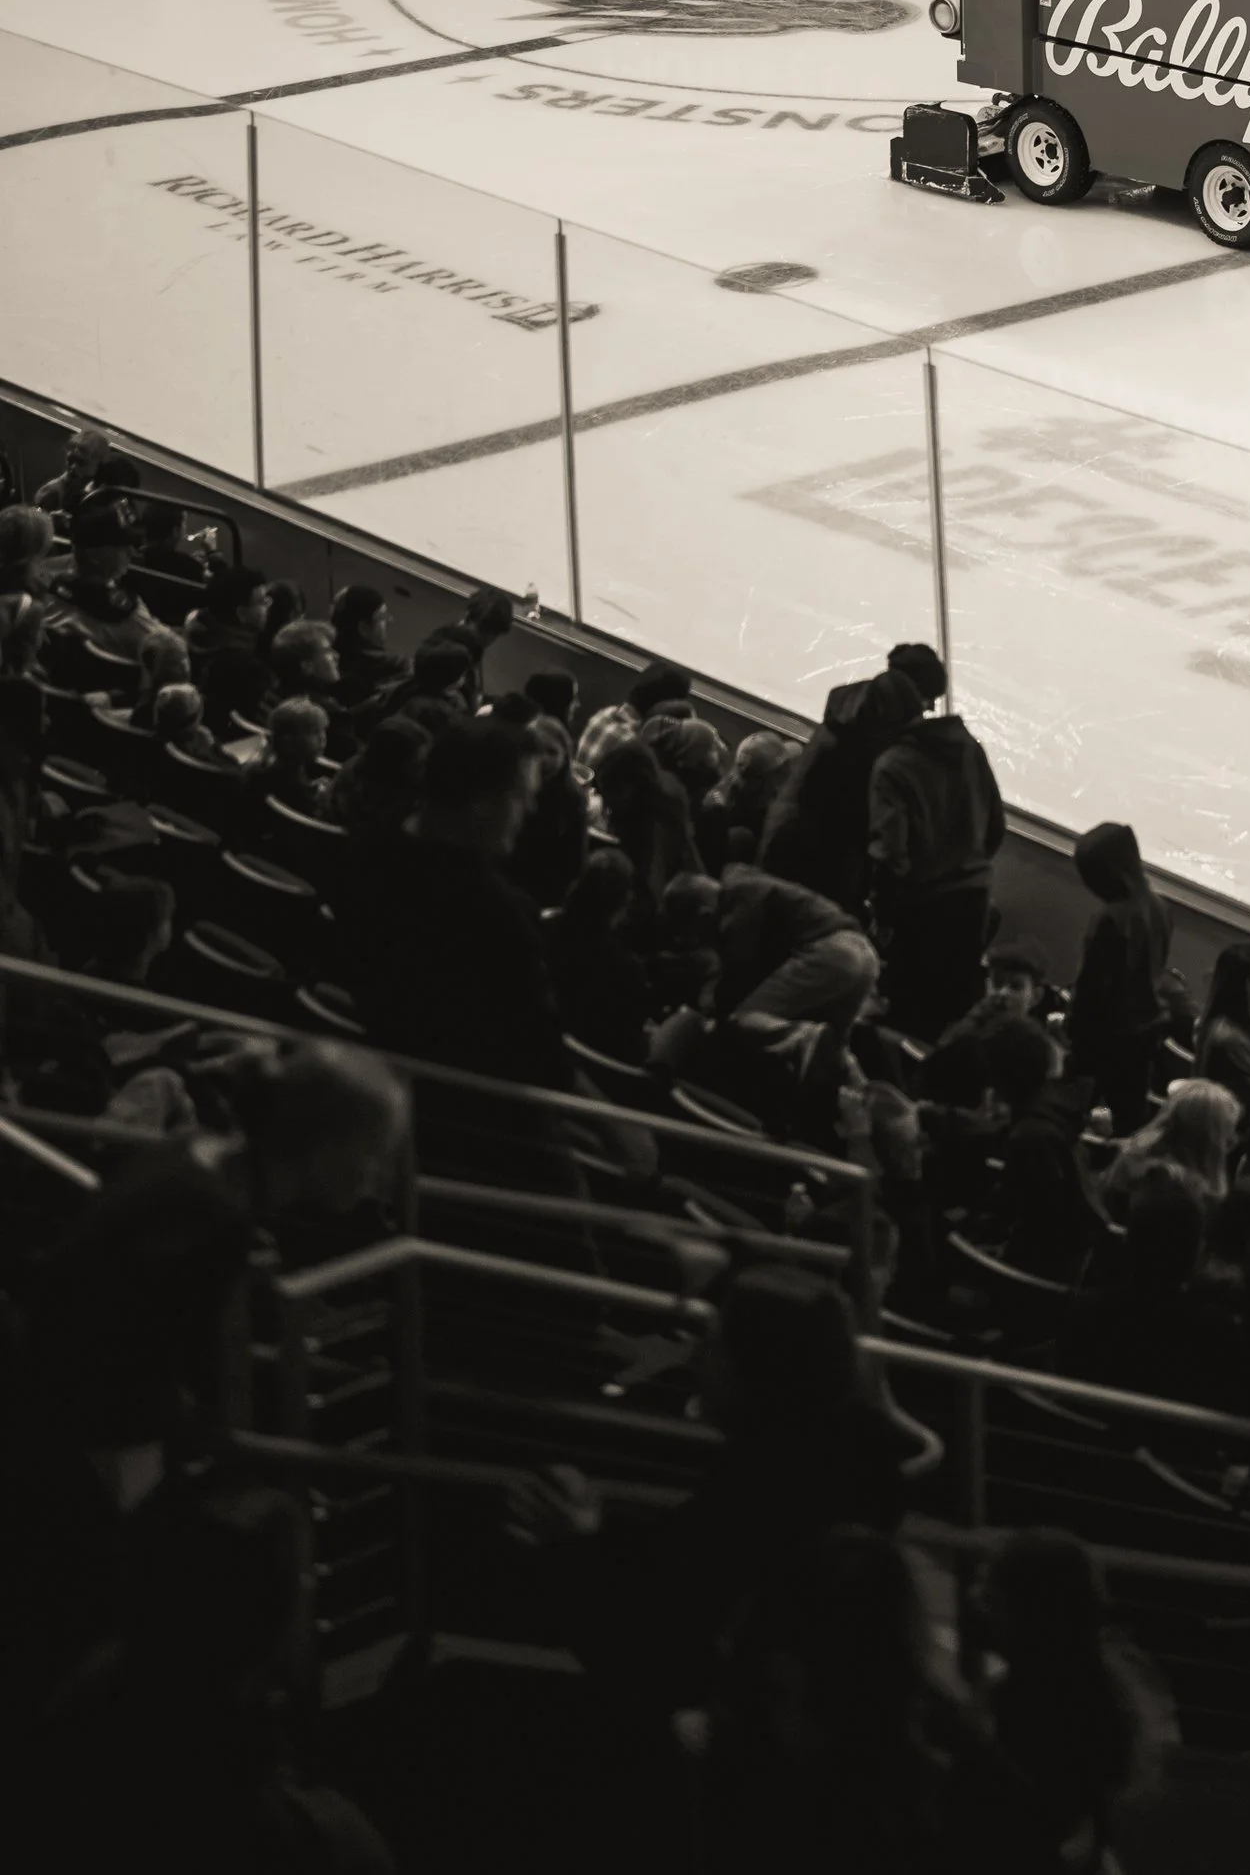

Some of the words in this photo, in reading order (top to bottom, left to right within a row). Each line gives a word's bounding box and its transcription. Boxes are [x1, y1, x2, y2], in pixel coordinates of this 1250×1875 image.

[147, 173, 351, 250] RICHARD
[340, 241, 531, 312] HARRIS
[204, 220, 294, 253] LAW
[294, 255, 405, 297] FIRM
